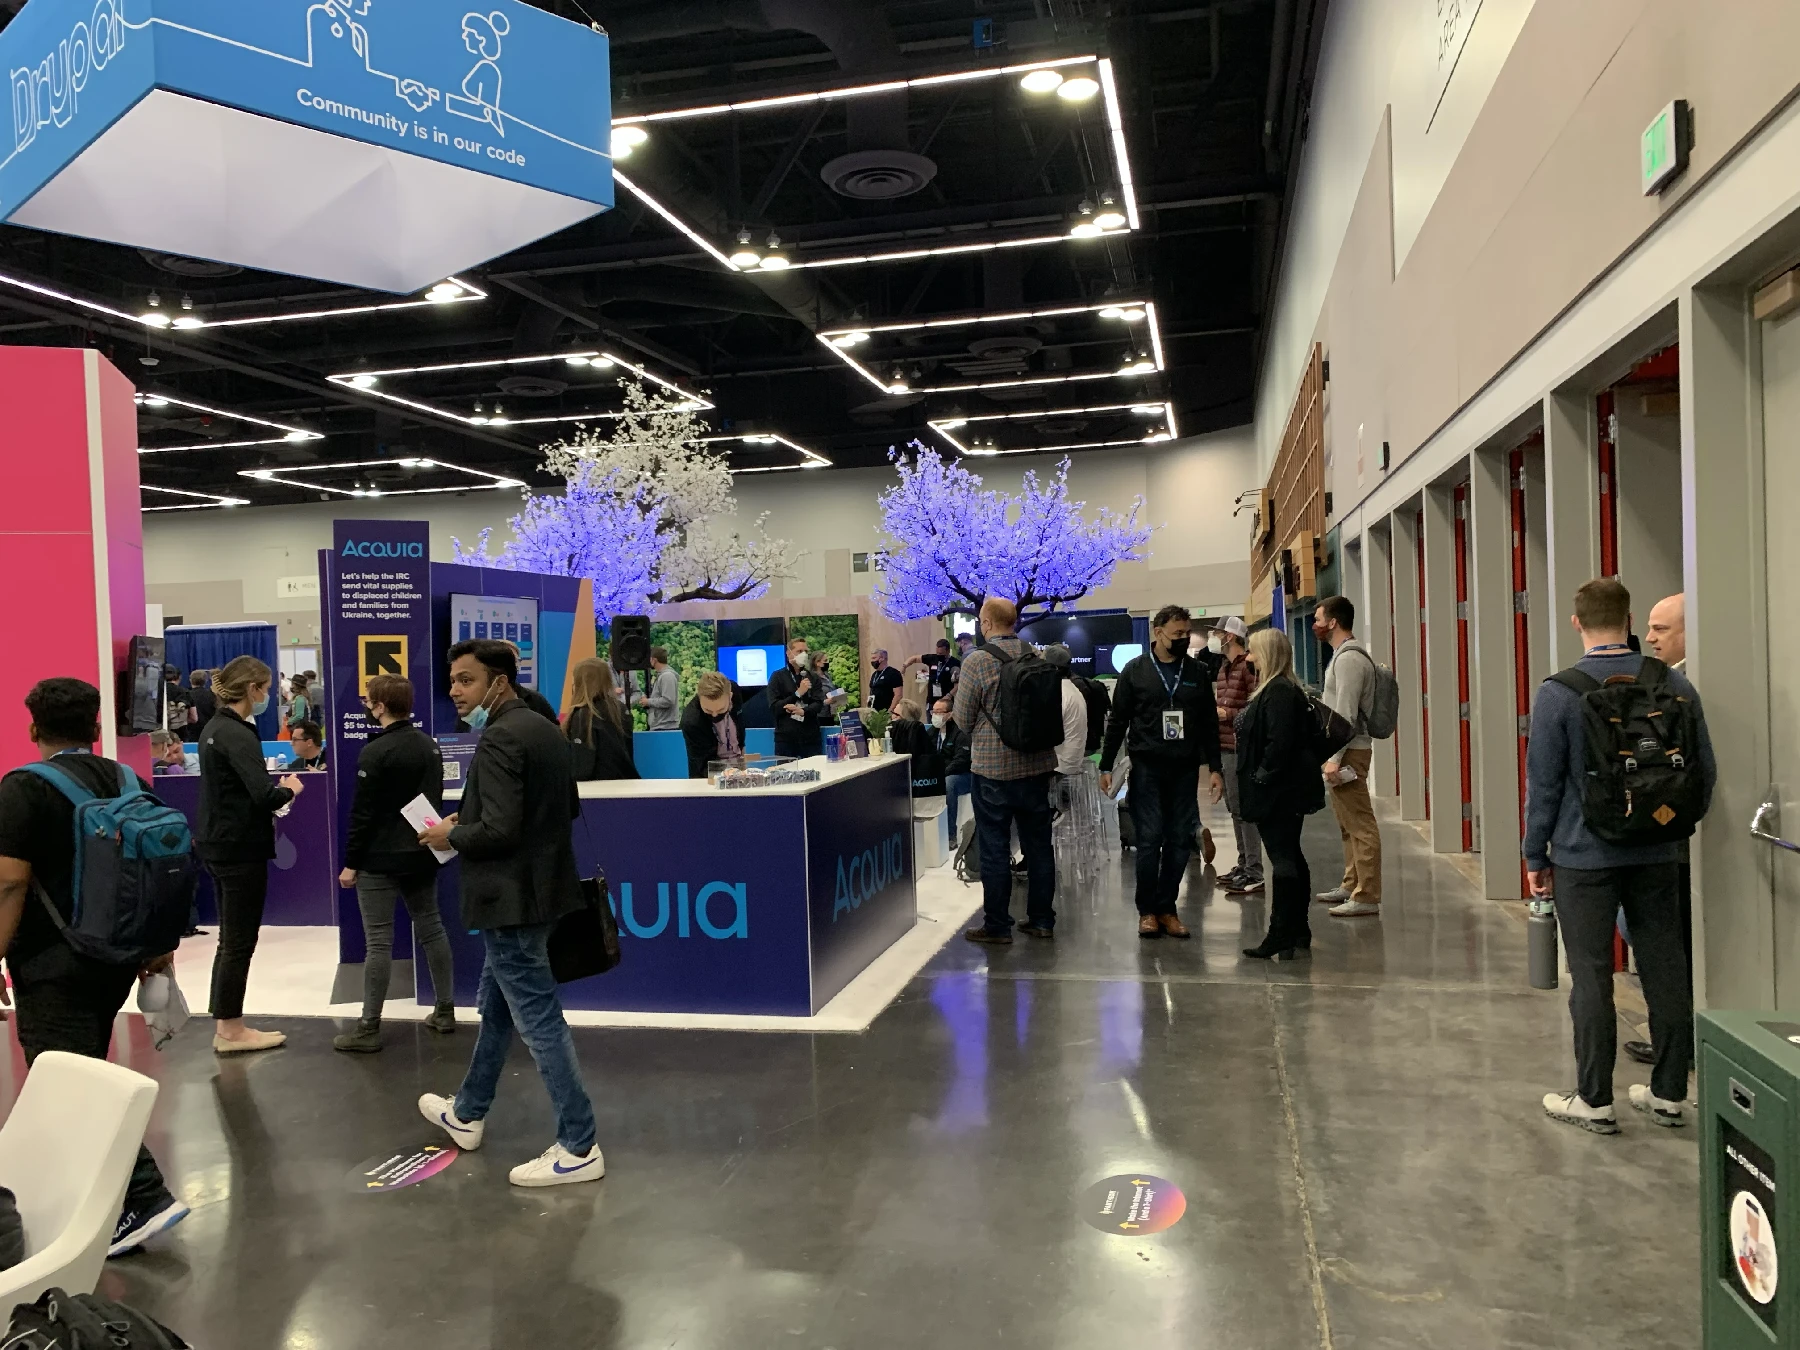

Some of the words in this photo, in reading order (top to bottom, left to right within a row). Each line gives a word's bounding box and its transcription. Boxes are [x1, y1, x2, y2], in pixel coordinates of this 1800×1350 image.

[296, 88, 409, 137] Community
[413, 121, 428, 139] is
[433, 126, 449, 146] in
[453, 137, 482, 154] our
[486, 144, 526, 167] code
[341, 572, 361, 580] Let's
[361, 572, 380, 581] help
[381, 572, 395, 580] the
[395, 572, 410, 580] IRC
[341, 582, 361, 590] send
[362, 582, 380, 590] vital
[381, 582, 413, 591] supplies
[352, 592, 389, 600] displaced
[376, 612, 412, 620] together.
[343, 712, 367, 720] Acqui
[343, 721, 355, 729] $5
